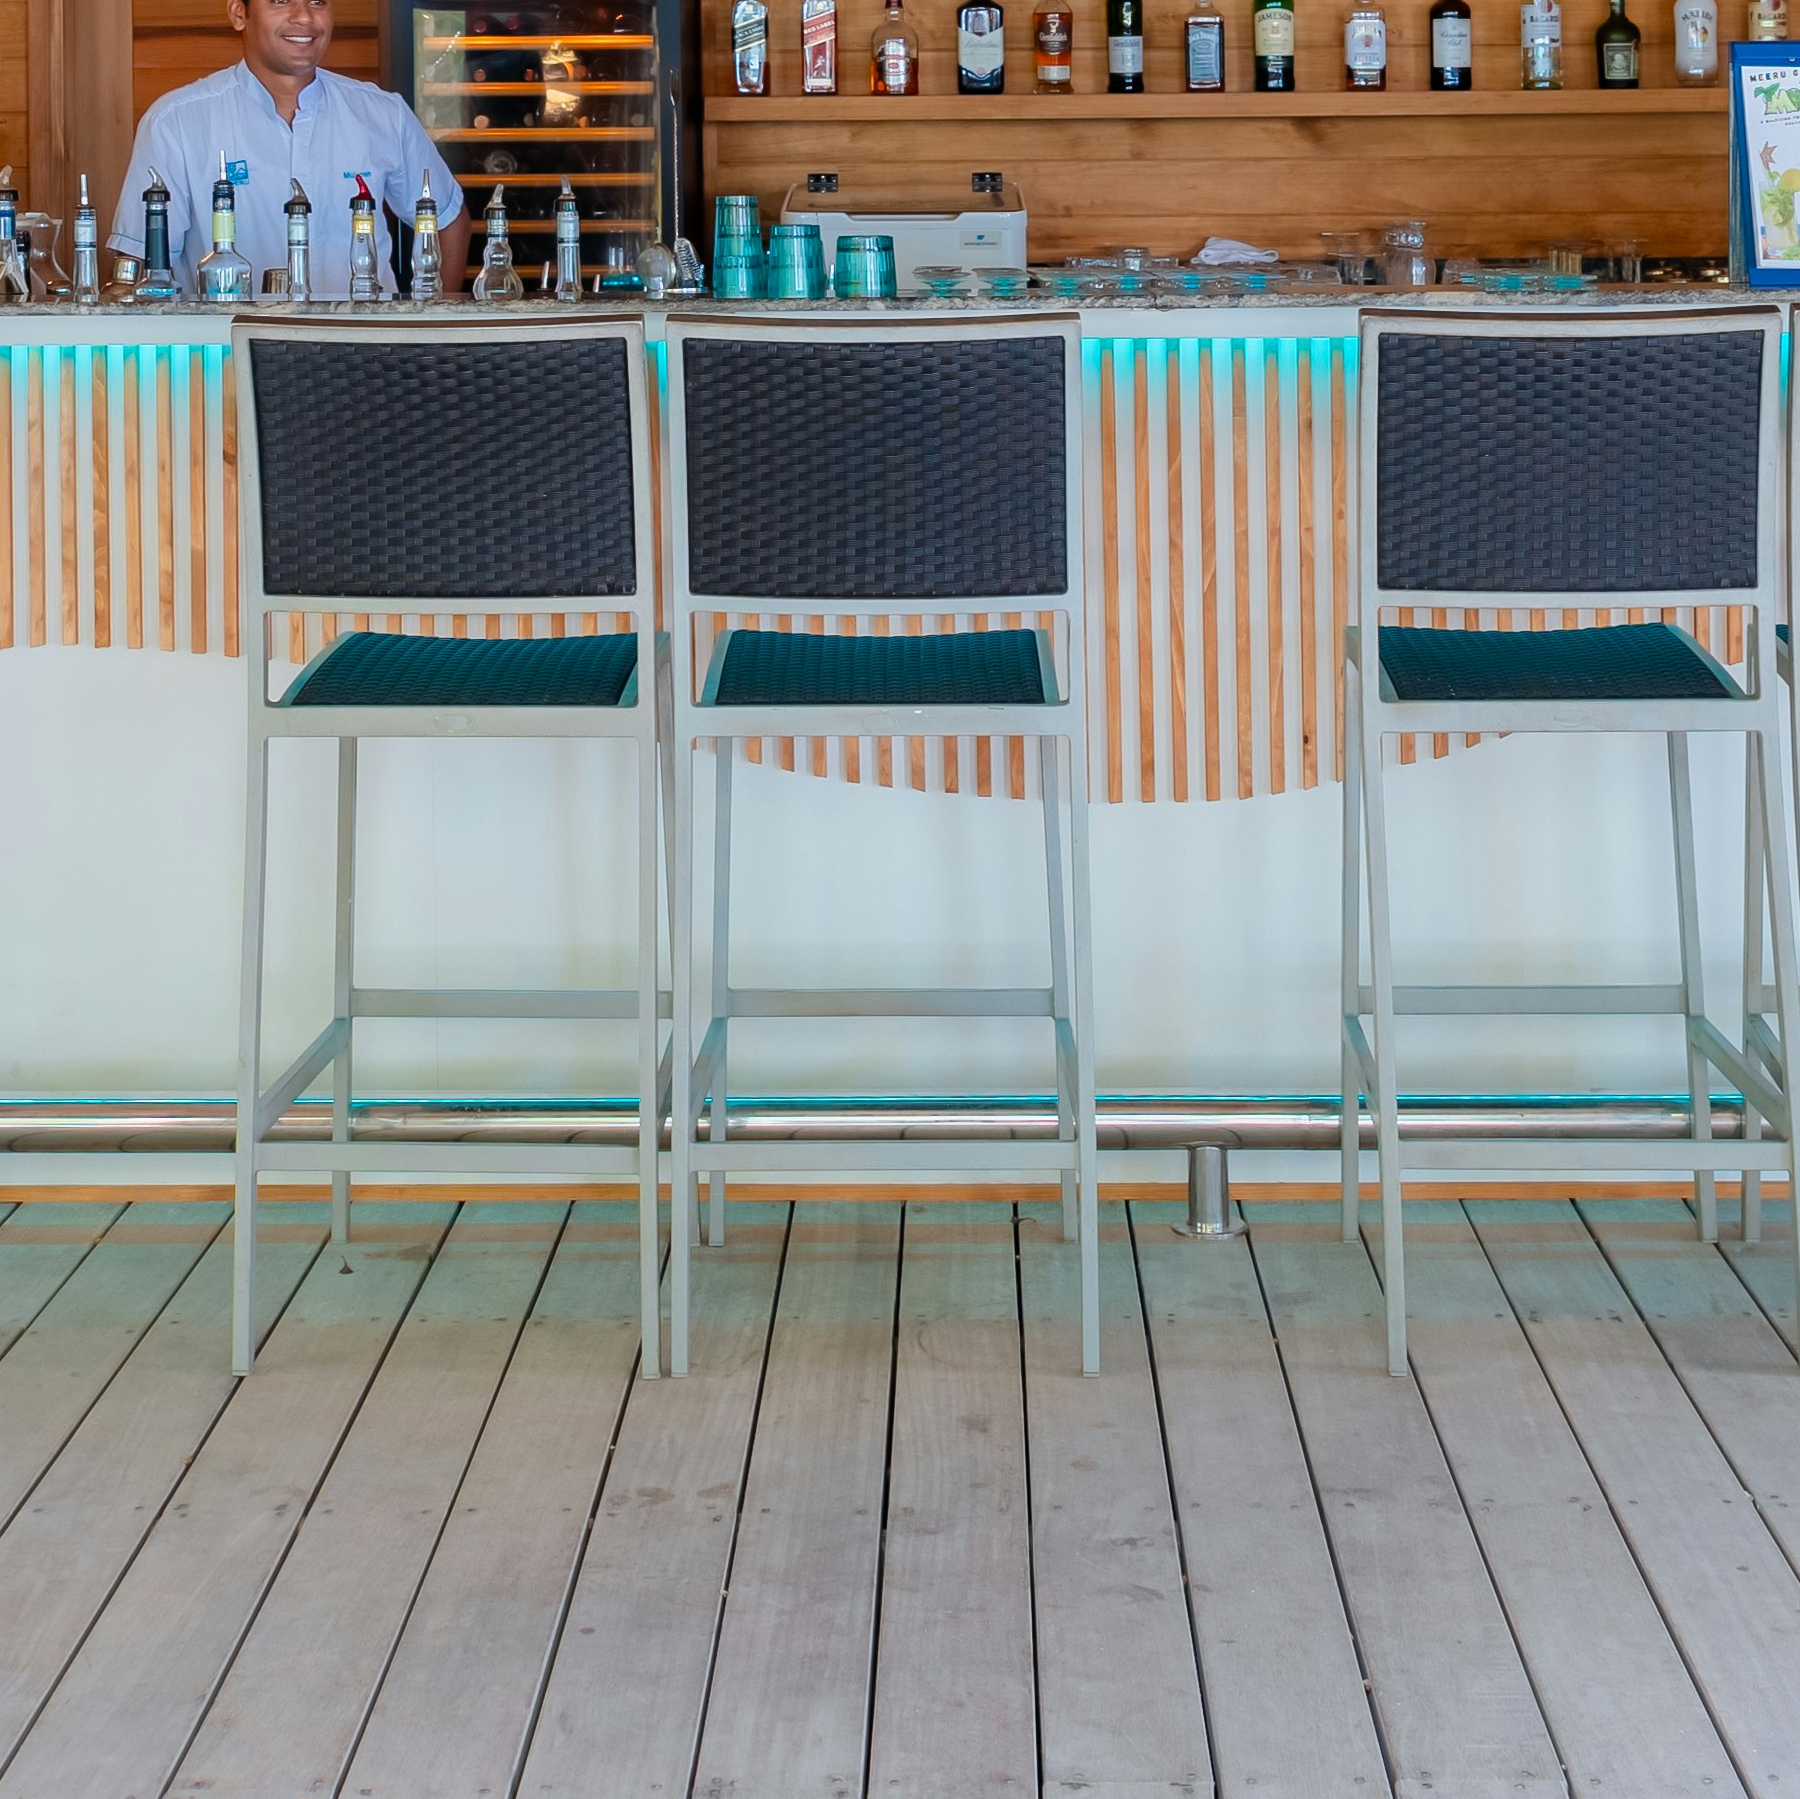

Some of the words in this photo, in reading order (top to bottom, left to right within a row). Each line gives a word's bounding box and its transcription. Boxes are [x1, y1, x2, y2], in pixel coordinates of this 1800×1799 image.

[1257, 11, 1292, 24] JAMESON
[1529, 15, 1559, 23] BACARD
[1749, 71, 1787, 82] MEERU
